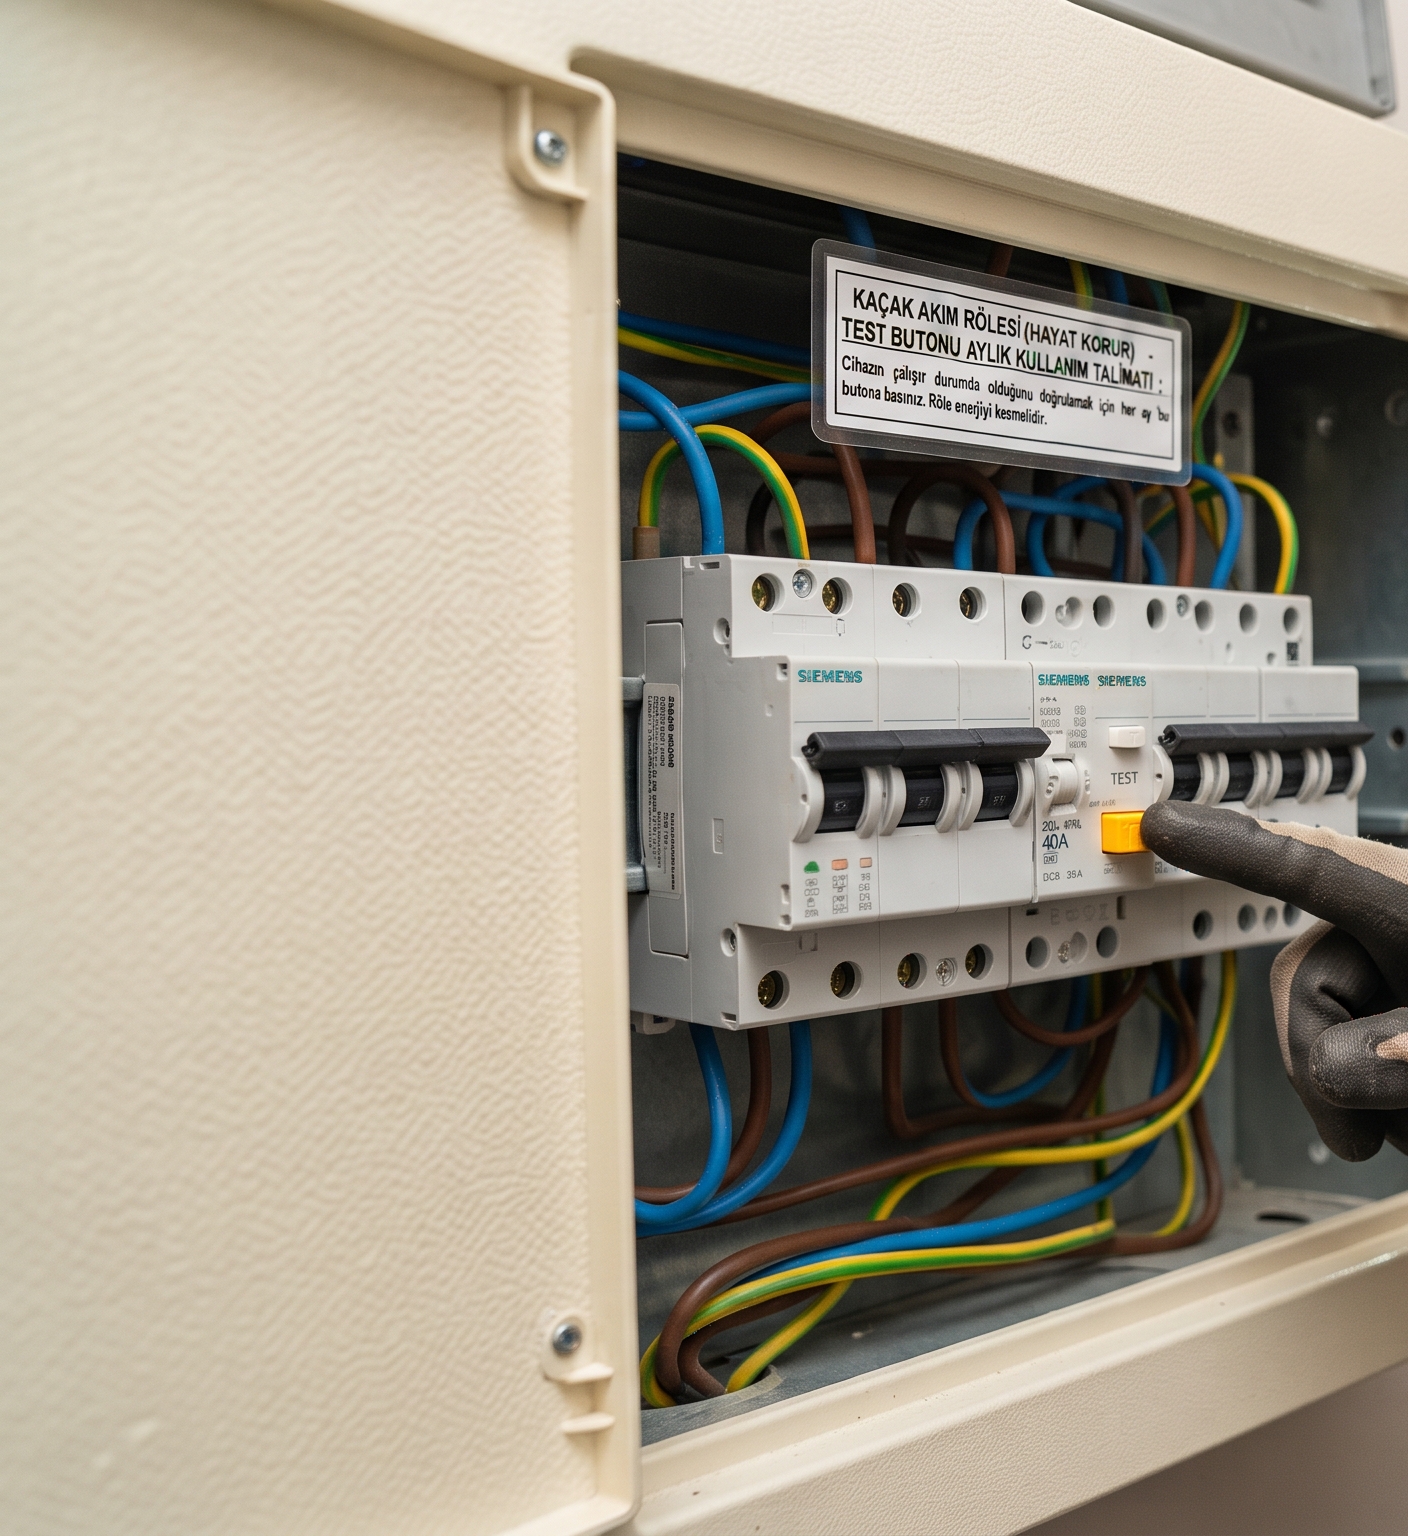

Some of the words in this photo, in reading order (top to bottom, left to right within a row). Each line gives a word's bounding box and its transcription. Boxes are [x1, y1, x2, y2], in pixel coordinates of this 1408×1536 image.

[842, 316, 886, 344] TEST
[891, 326, 961, 357] BUTONU
[966, 340, 1012, 365] AYLIK
[1016, 347, 1088, 380] KULLANIM
[853, 287, 914, 319] KAÇAK
[917, 301, 959, 327] AKIM
[964, 306, 1021, 338] RÖLESİ
[1024, 321, 1078, 349] (HAYAT
[1081, 332, 1135, 366] KORUR)
[842, 355, 885, 377] Cihazın
[893, 364, 927, 386] çalışır
[934, 371, 980, 392] durumda
[988, 380, 1033, 402] olduğunu
[1040, 388, 1094, 411] doğrulamak
[1099, 398, 1115, 417] için
[1121, 401, 1137, 417] her
[842, 380, 881, 401] butona
[884, 386, 926, 407] basınız.
[929, 393, 952, 411] Röle
[955, 401, 992, 421] enerjiyi
[995, 404, 1048, 425] kesmelidir.
[797, 669, 863, 684] SIEMENS
[1110, 771, 1139, 786] TEST
[1042, 833, 1069, 851] 40A
